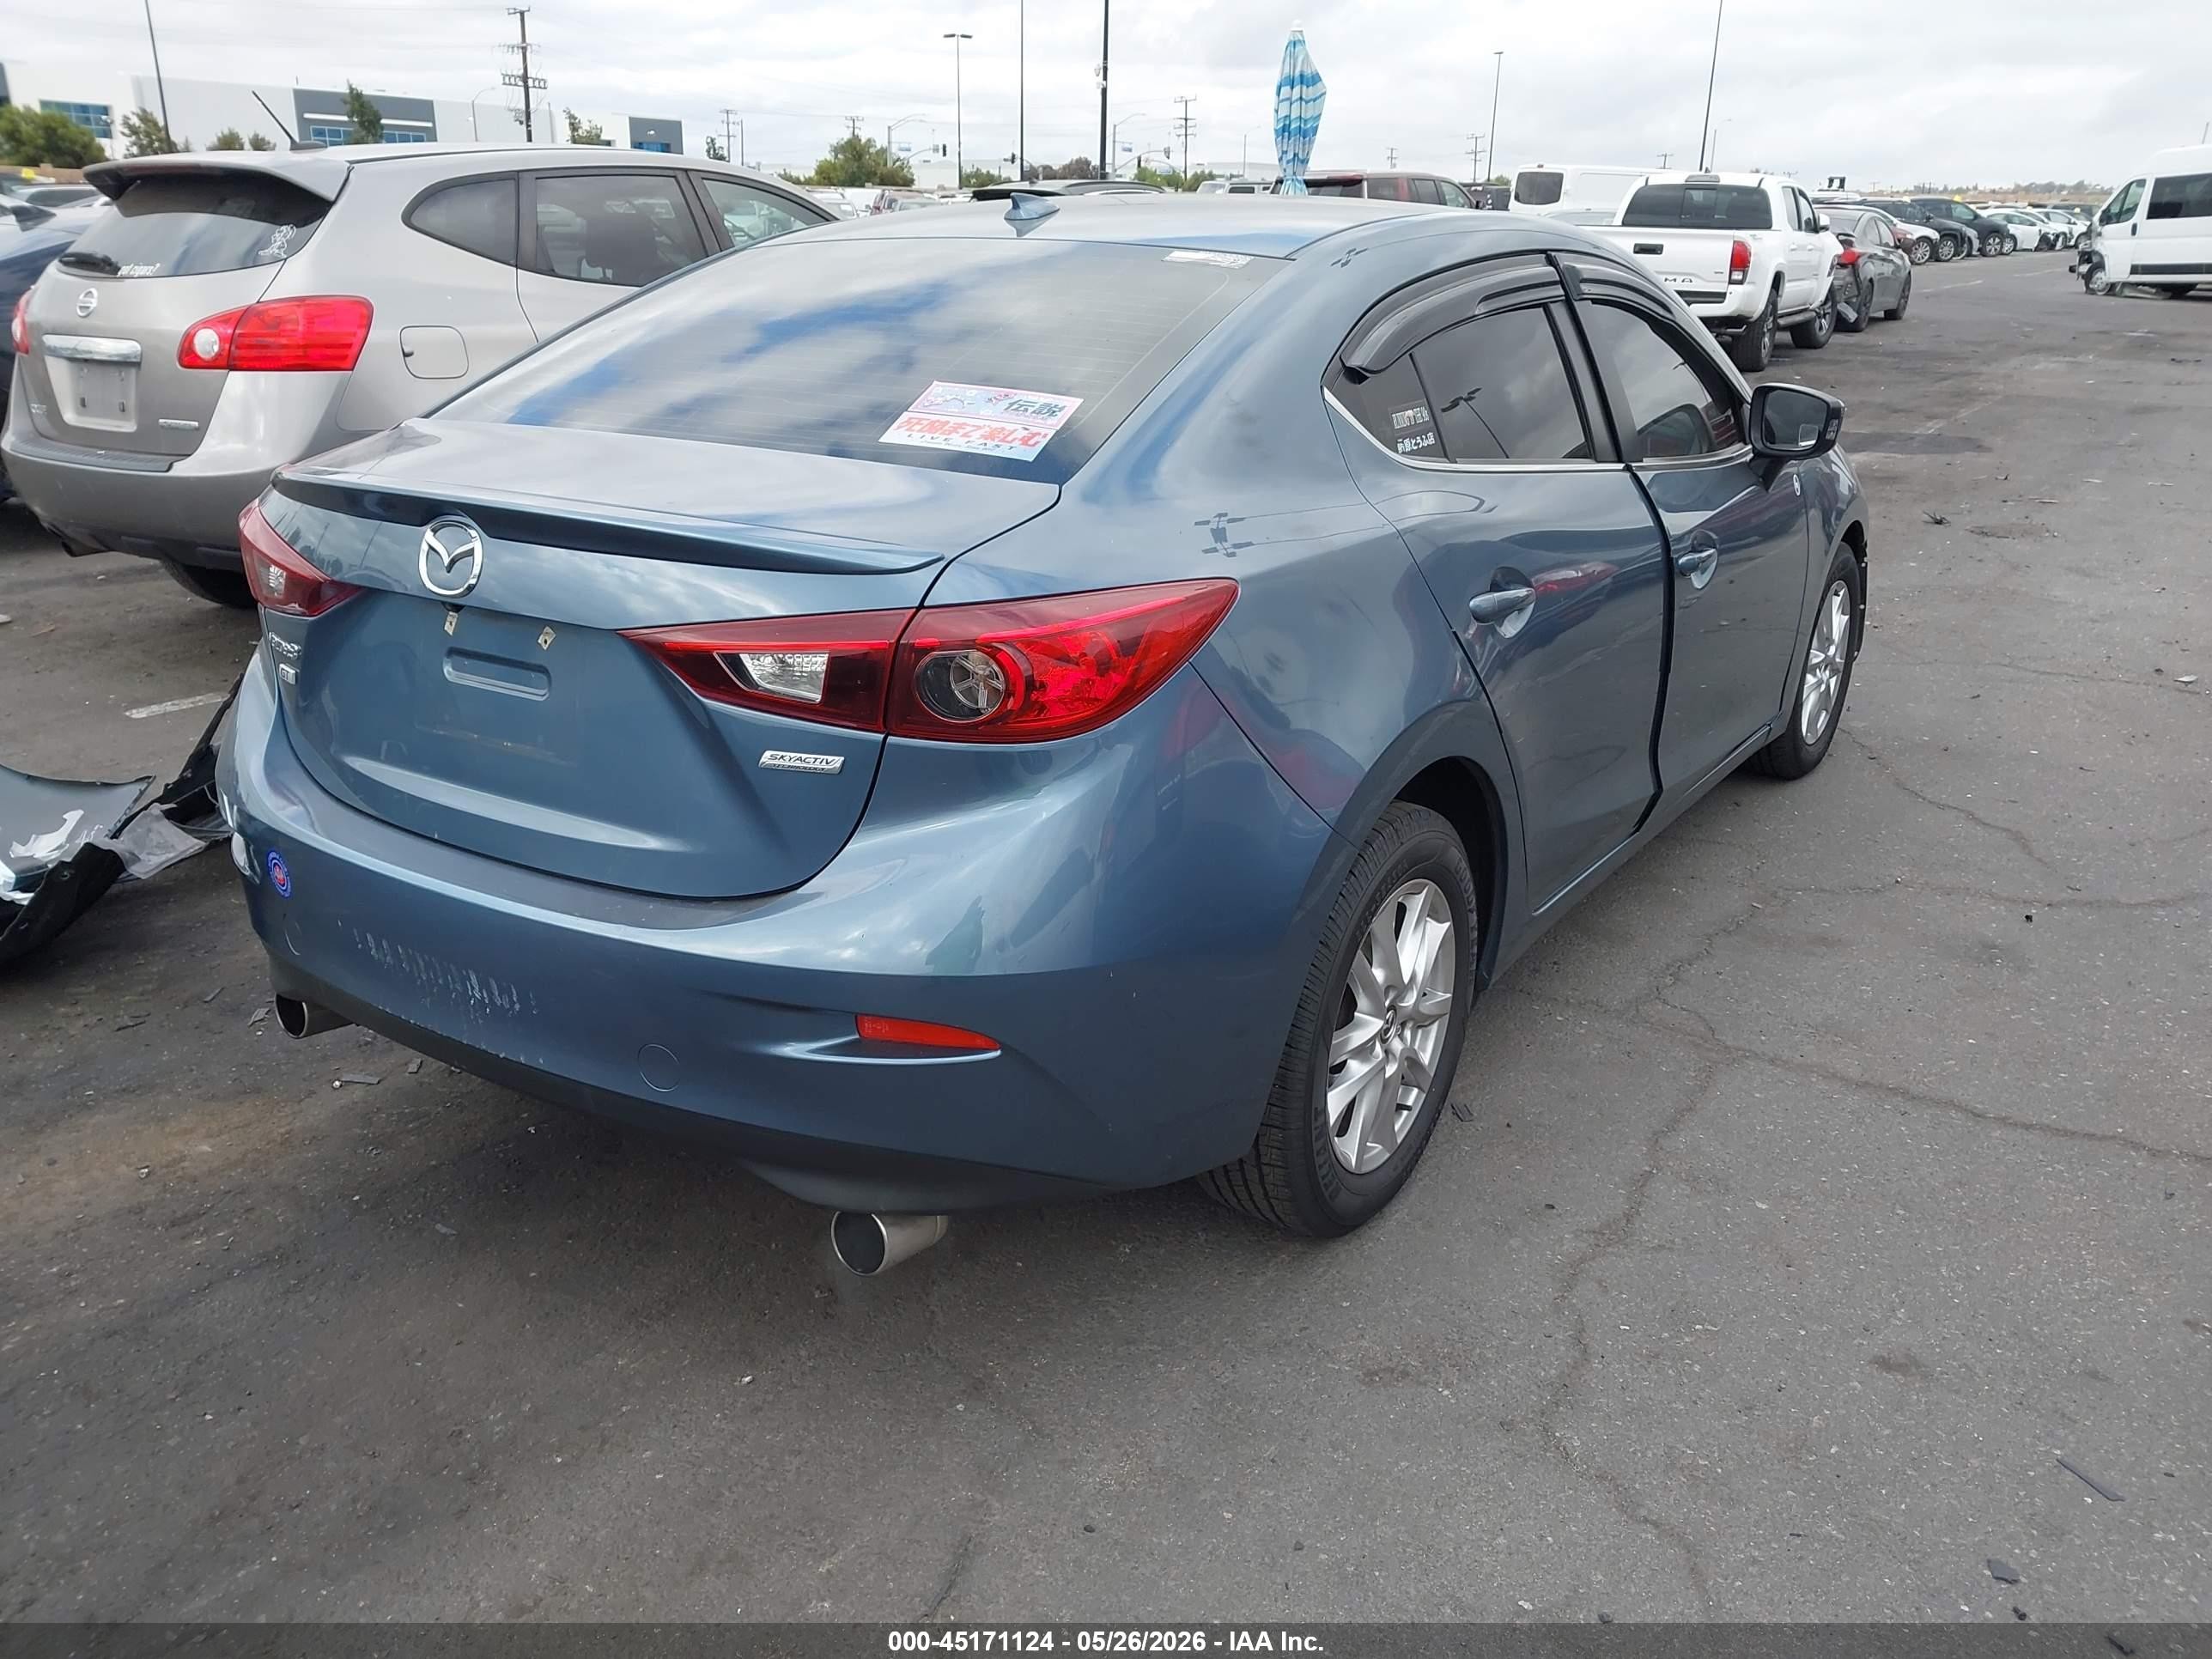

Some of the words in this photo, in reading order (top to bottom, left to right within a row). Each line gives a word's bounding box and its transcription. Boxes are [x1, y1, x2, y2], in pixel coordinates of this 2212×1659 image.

[1003, 399, 1067, 417] 伝説
[907, 433, 954, 442] LIVE
[964, 440, 1018, 451] FAST
[767, 753, 838, 766] SKYACTIV
